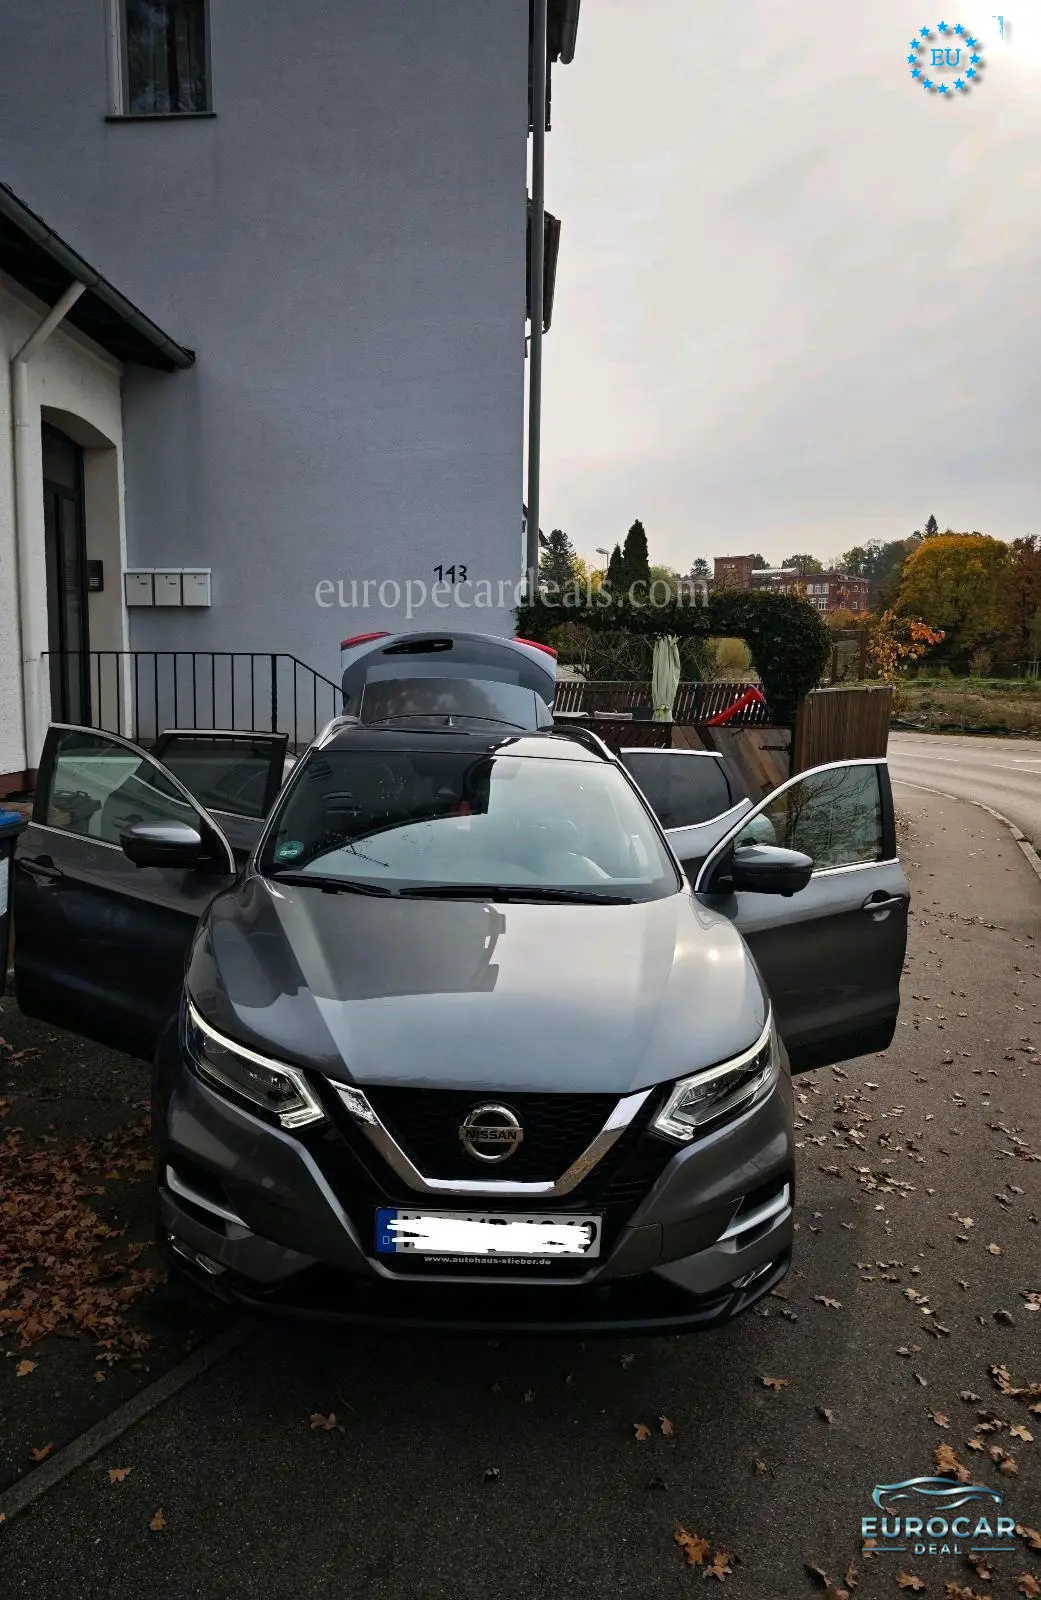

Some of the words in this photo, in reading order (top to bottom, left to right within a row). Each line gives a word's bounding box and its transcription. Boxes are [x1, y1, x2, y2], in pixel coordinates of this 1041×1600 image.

[433, 564, 468, 585] 143
[465, 1128, 518, 1140] NISSAN
[424, 1255, 552, 1266] www.autohaus-stieber.de
